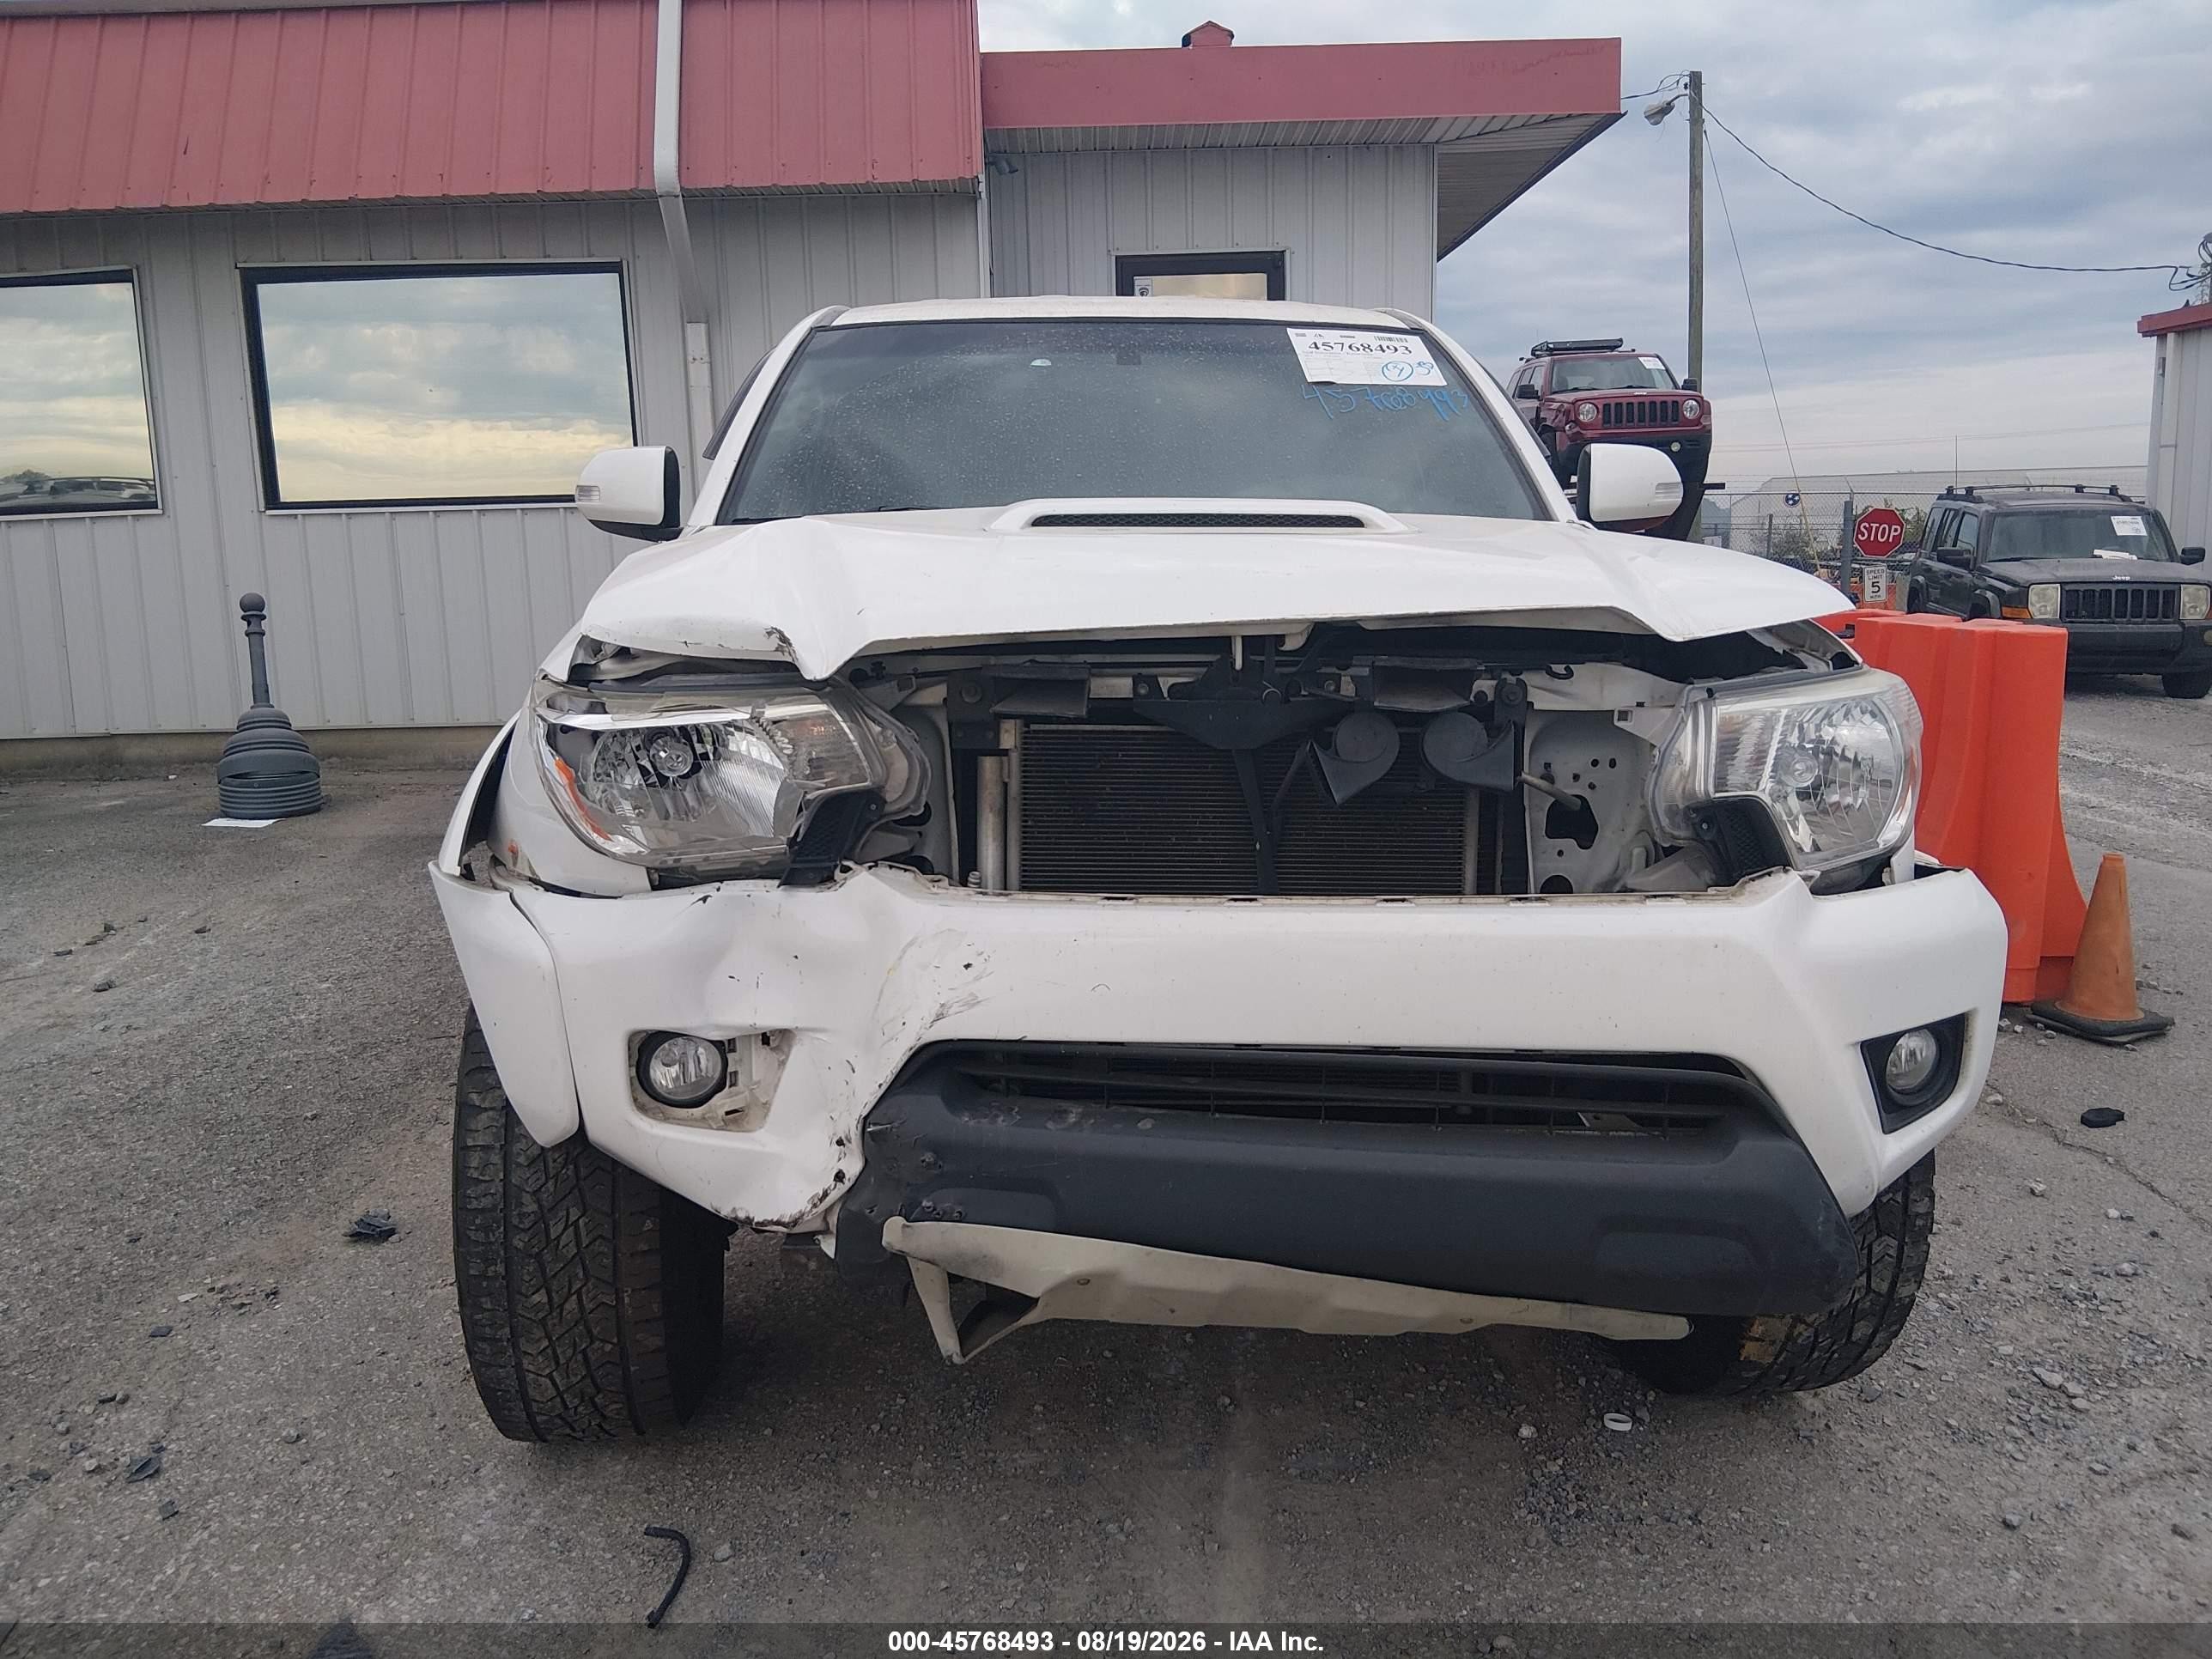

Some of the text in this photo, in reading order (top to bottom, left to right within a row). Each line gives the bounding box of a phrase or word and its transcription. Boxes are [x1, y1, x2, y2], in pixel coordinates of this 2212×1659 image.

[1308, 341, 1413, 355] 45768493
[1858, 522, 1900, 542] STOP
[1871, 580, 1881, 593] 5
